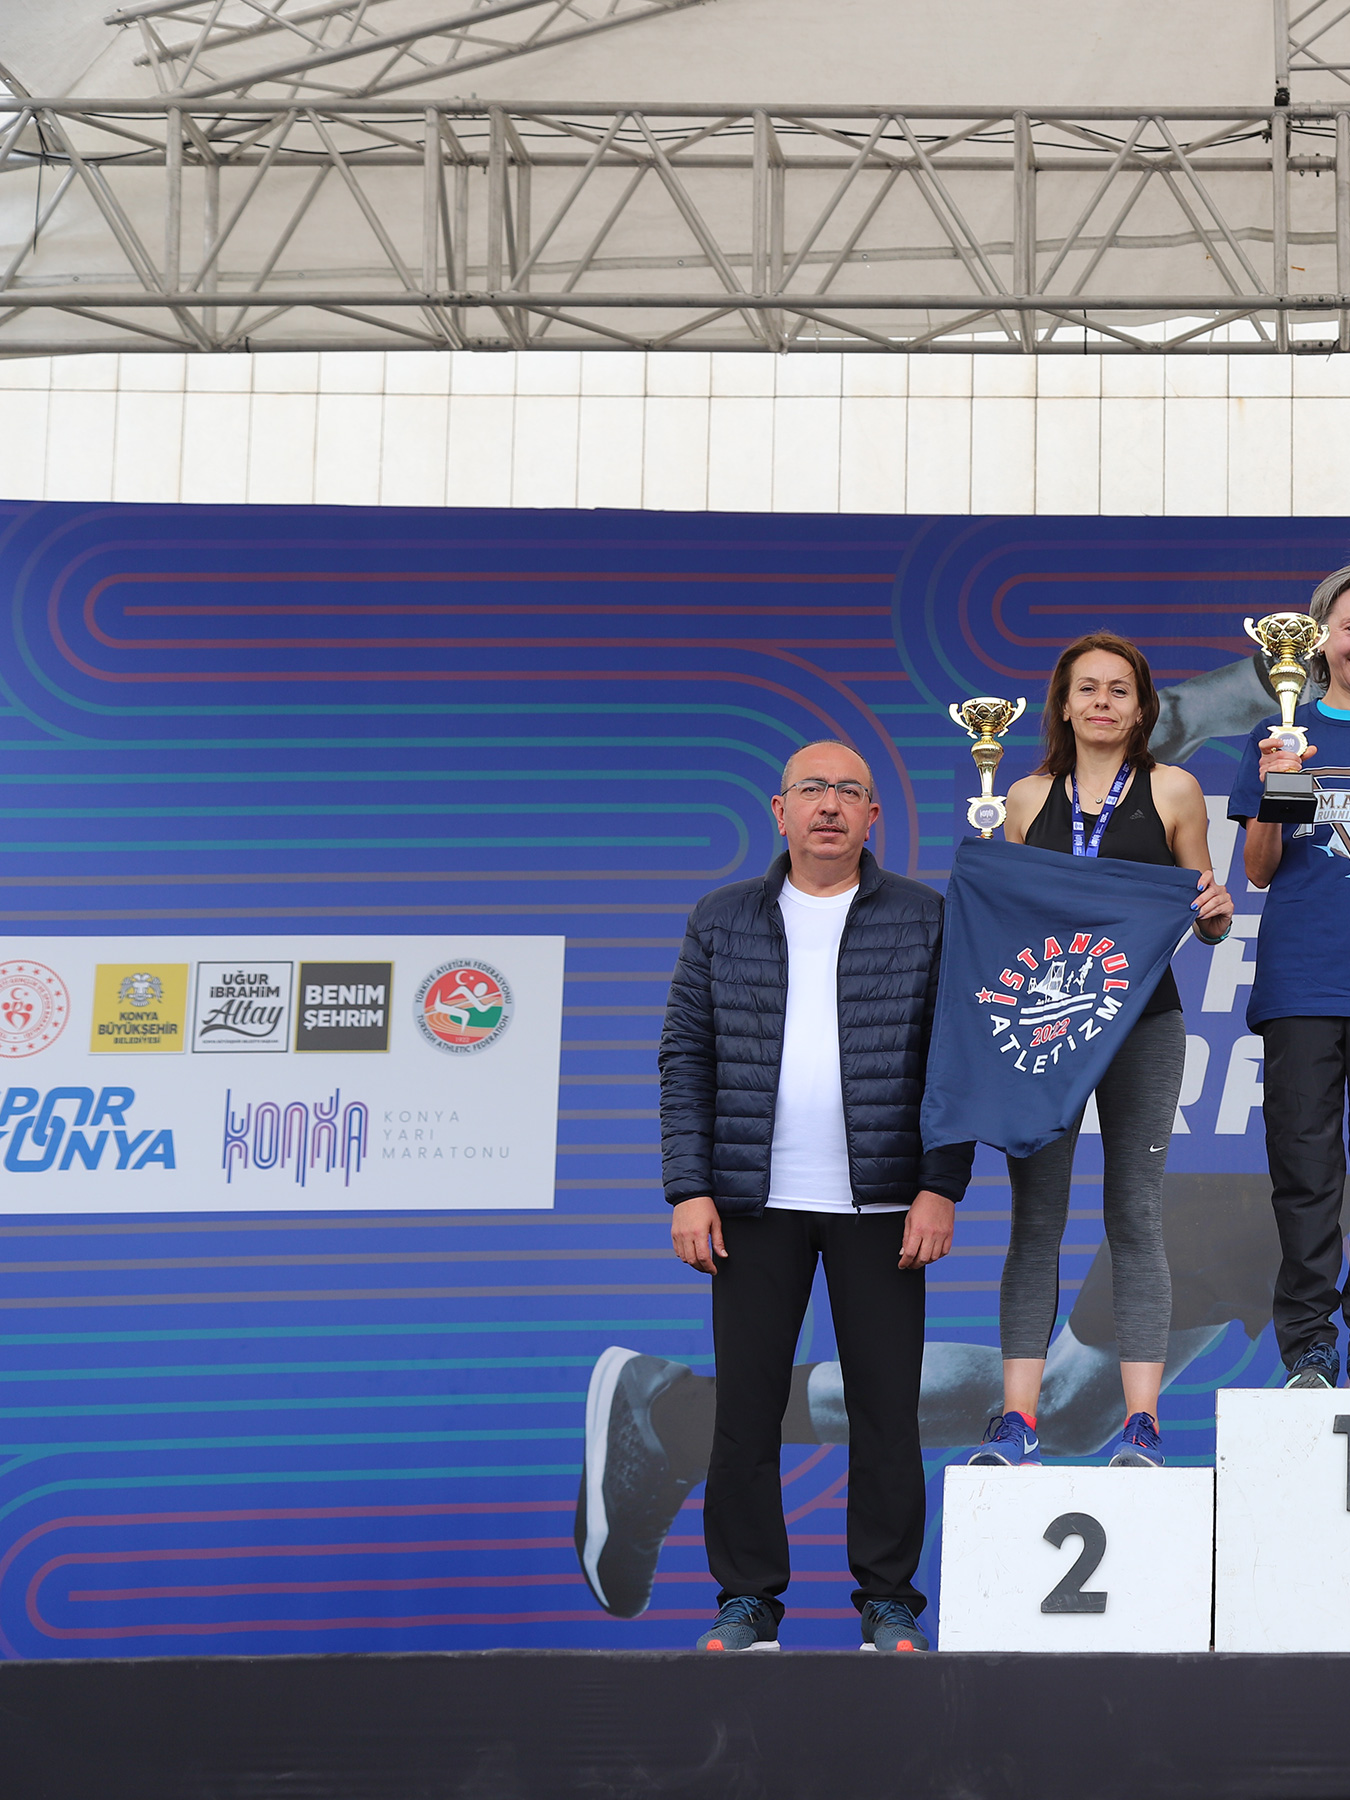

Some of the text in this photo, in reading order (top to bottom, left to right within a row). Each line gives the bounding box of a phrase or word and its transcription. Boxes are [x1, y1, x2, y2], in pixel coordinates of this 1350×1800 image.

[222, 970, 269, 985] UĞUR
[473, 961, 512, 1005] FEDERASYONU
[119, 1012, 158, 1021] KONYA
[200, 999, 284, 1037] Altay
[1029, 1017, 1071, 1047] 2022
[436, 1040, 471, 1054] ATHLETIC
[473, 1014, 509, 1052] FEDERATION
[0, 1086, 135, 1147] POR
[383, 1111, 460, 1124] KONYA
[0, 1115, 176, 1173] ONYA
[382, 1128, 434, 1141] YARI
[382, 1146, 510, 1159] MARATONU
[1041, 1511, 1109, 1614] 2
